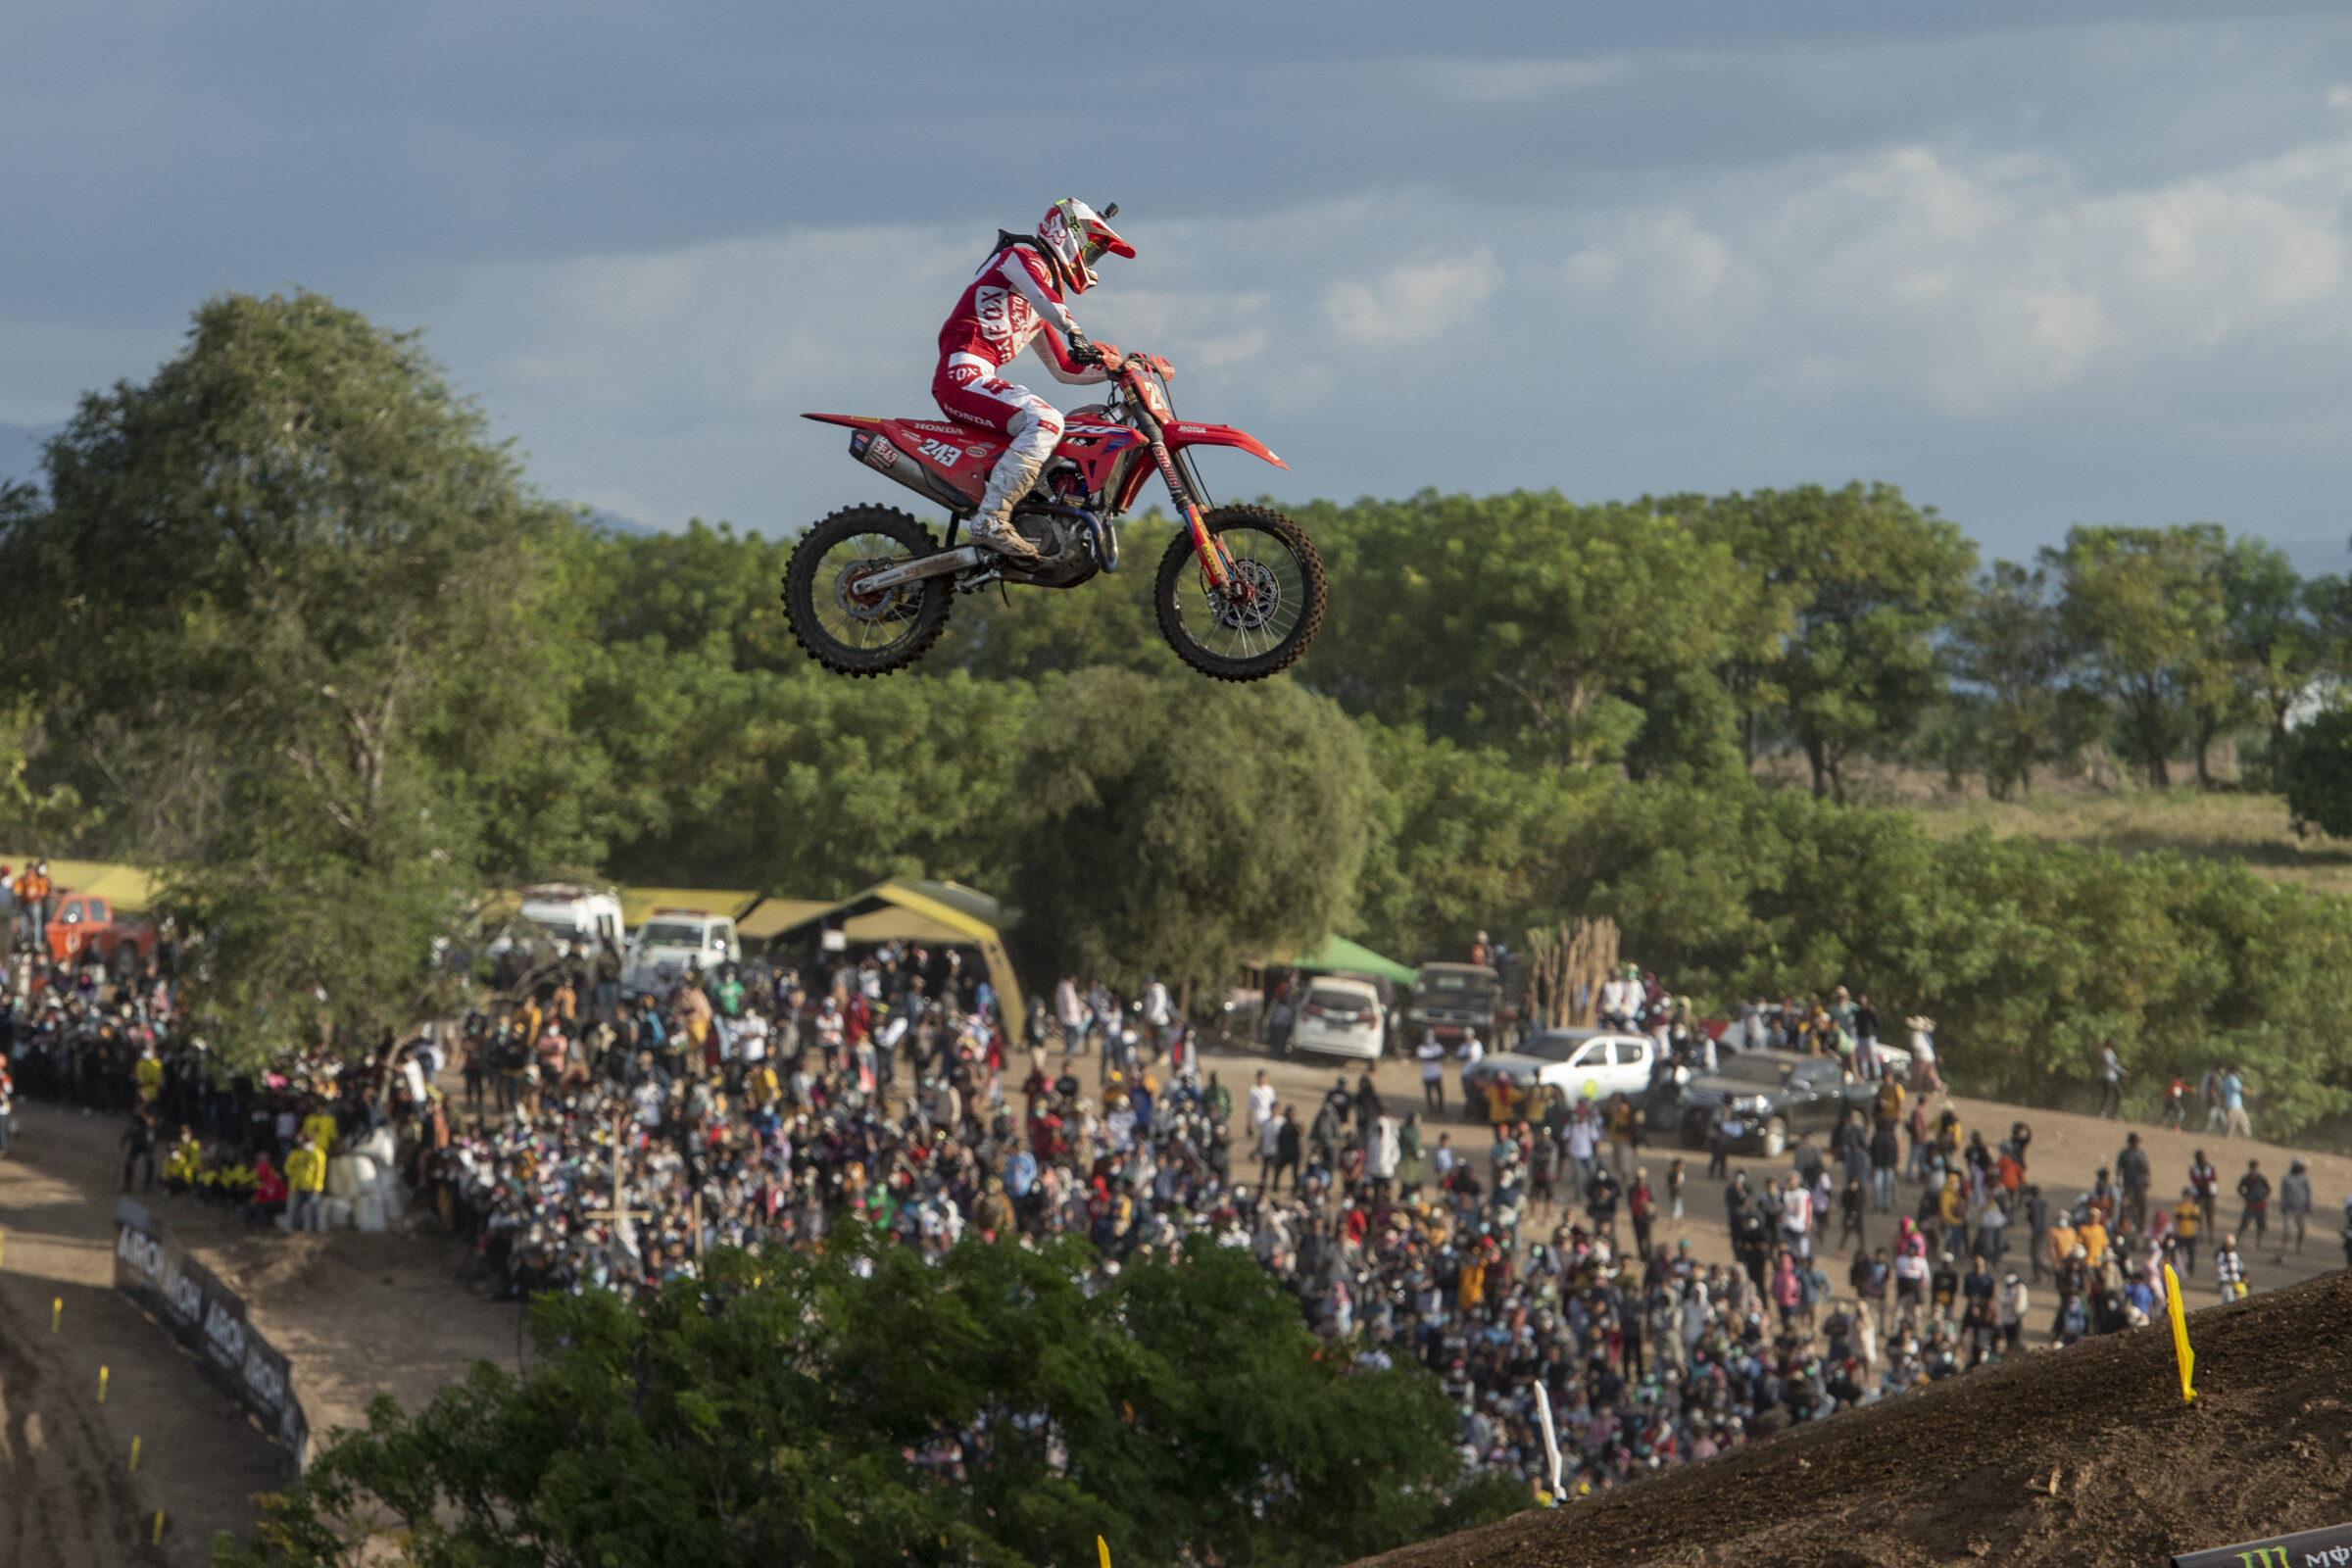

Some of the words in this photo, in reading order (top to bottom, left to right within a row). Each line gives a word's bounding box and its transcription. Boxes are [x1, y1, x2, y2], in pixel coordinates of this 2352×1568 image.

[982, 291, 1007, 335] FOX
[948, 368, 978, 381] FOX
[944, 402, 996, 428] HONDA
[914, 422, 964, 436] HONDA
[917, 438, 962, 467] 243
[1153, 447, 1181, 488] SHOWA
